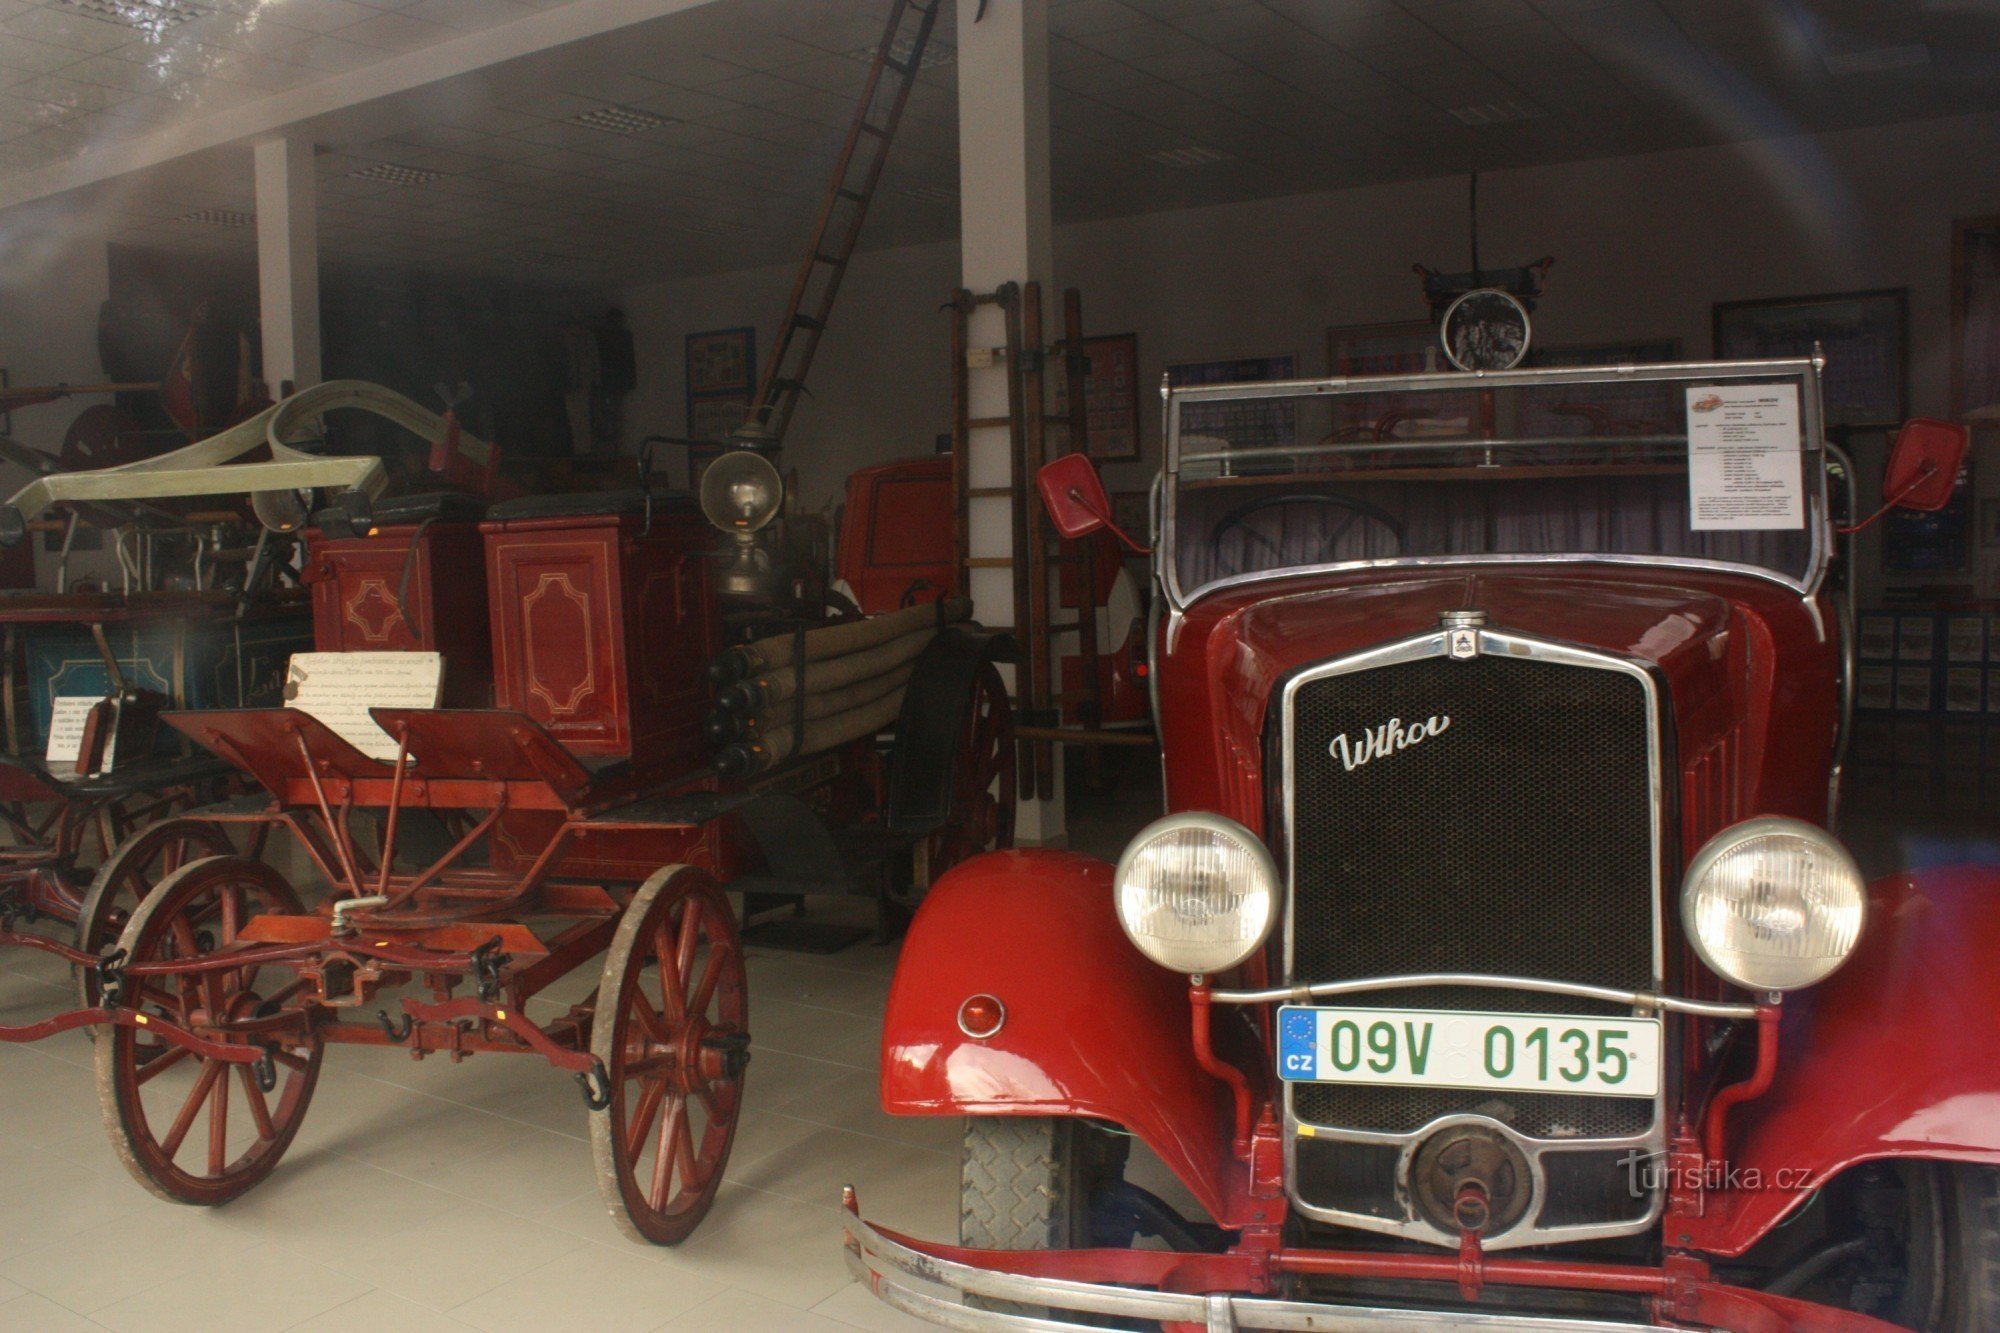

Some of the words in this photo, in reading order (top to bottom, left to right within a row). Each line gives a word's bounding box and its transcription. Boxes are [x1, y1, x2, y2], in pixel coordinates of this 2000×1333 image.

[1328, 715, 1451, 772] Wikov
[1286, 1054, 1313, 1072] CZ
[1331, 1019, 1433, 1076] 09V
[1484, 1025, 1629, 1084] 0135
